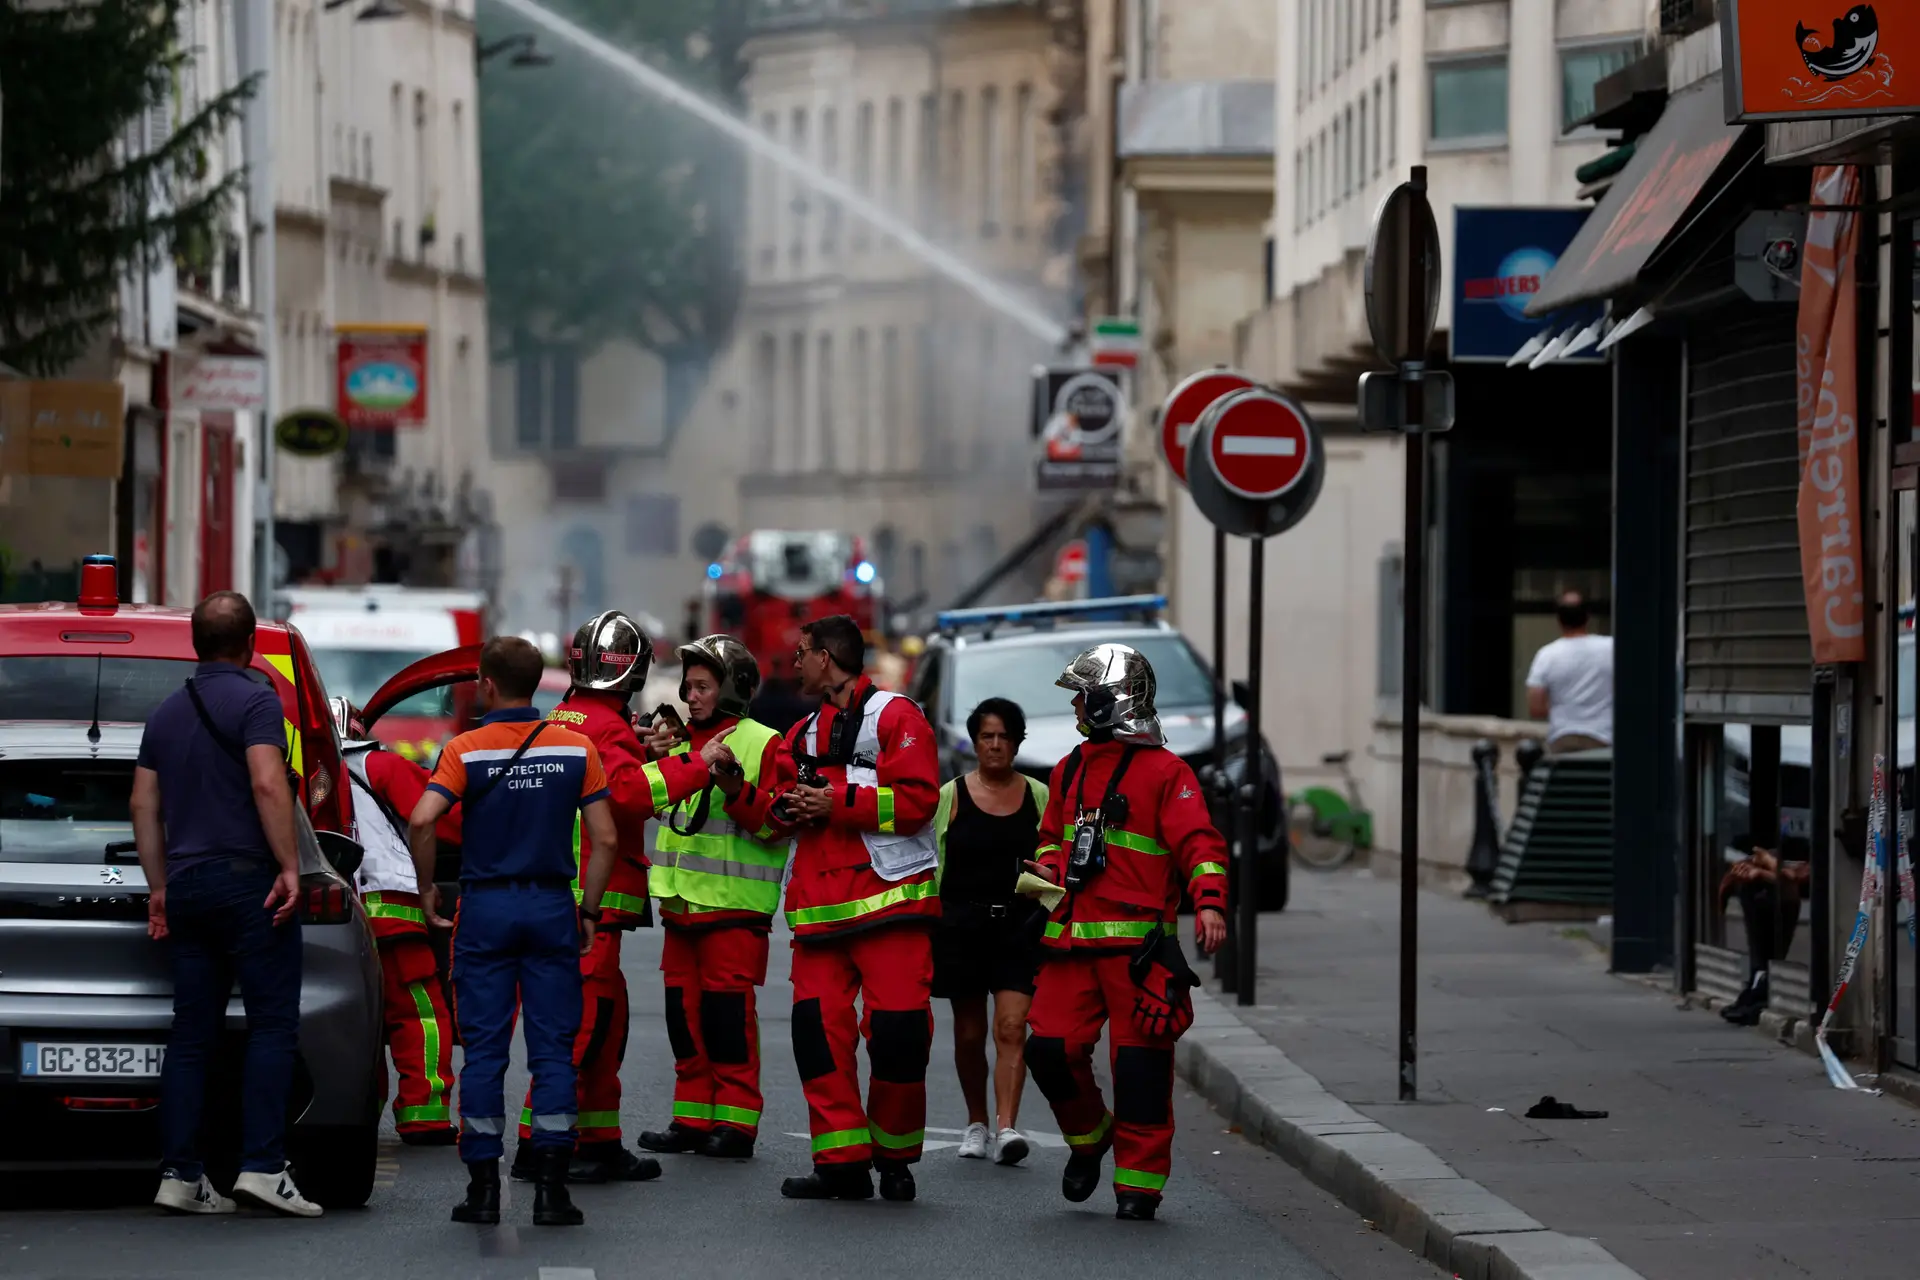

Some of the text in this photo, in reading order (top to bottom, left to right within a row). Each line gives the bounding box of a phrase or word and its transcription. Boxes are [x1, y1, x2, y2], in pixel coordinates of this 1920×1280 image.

[1464, 275, 1541, 298] VERS
[507, 778, 544, 789] CIVILE
[58, 896, 150, 904] PEUGEO
[40, 1046, 167, 1074] GC-832-H
